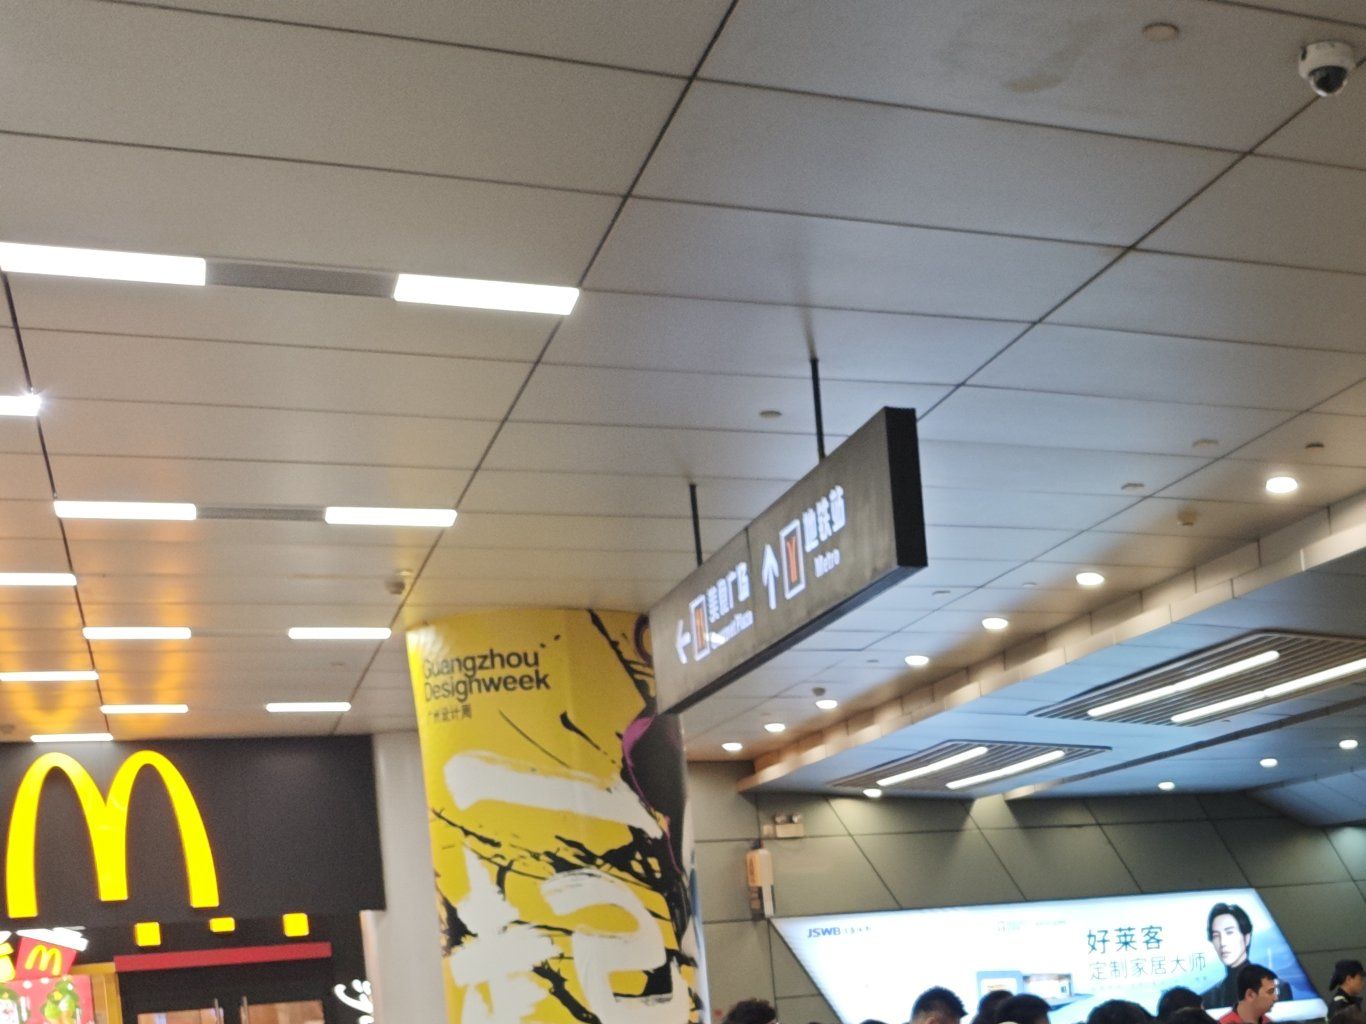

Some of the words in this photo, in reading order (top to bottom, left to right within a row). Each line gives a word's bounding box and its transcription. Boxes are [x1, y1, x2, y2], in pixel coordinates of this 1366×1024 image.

[423, 648, 539, 679] Guangzhou
[424, 669, 552, 703] Designweek
[1087, 925, 1164, 955] 好莱客
[1089, 952, 1206, 980] 定制家居大师
